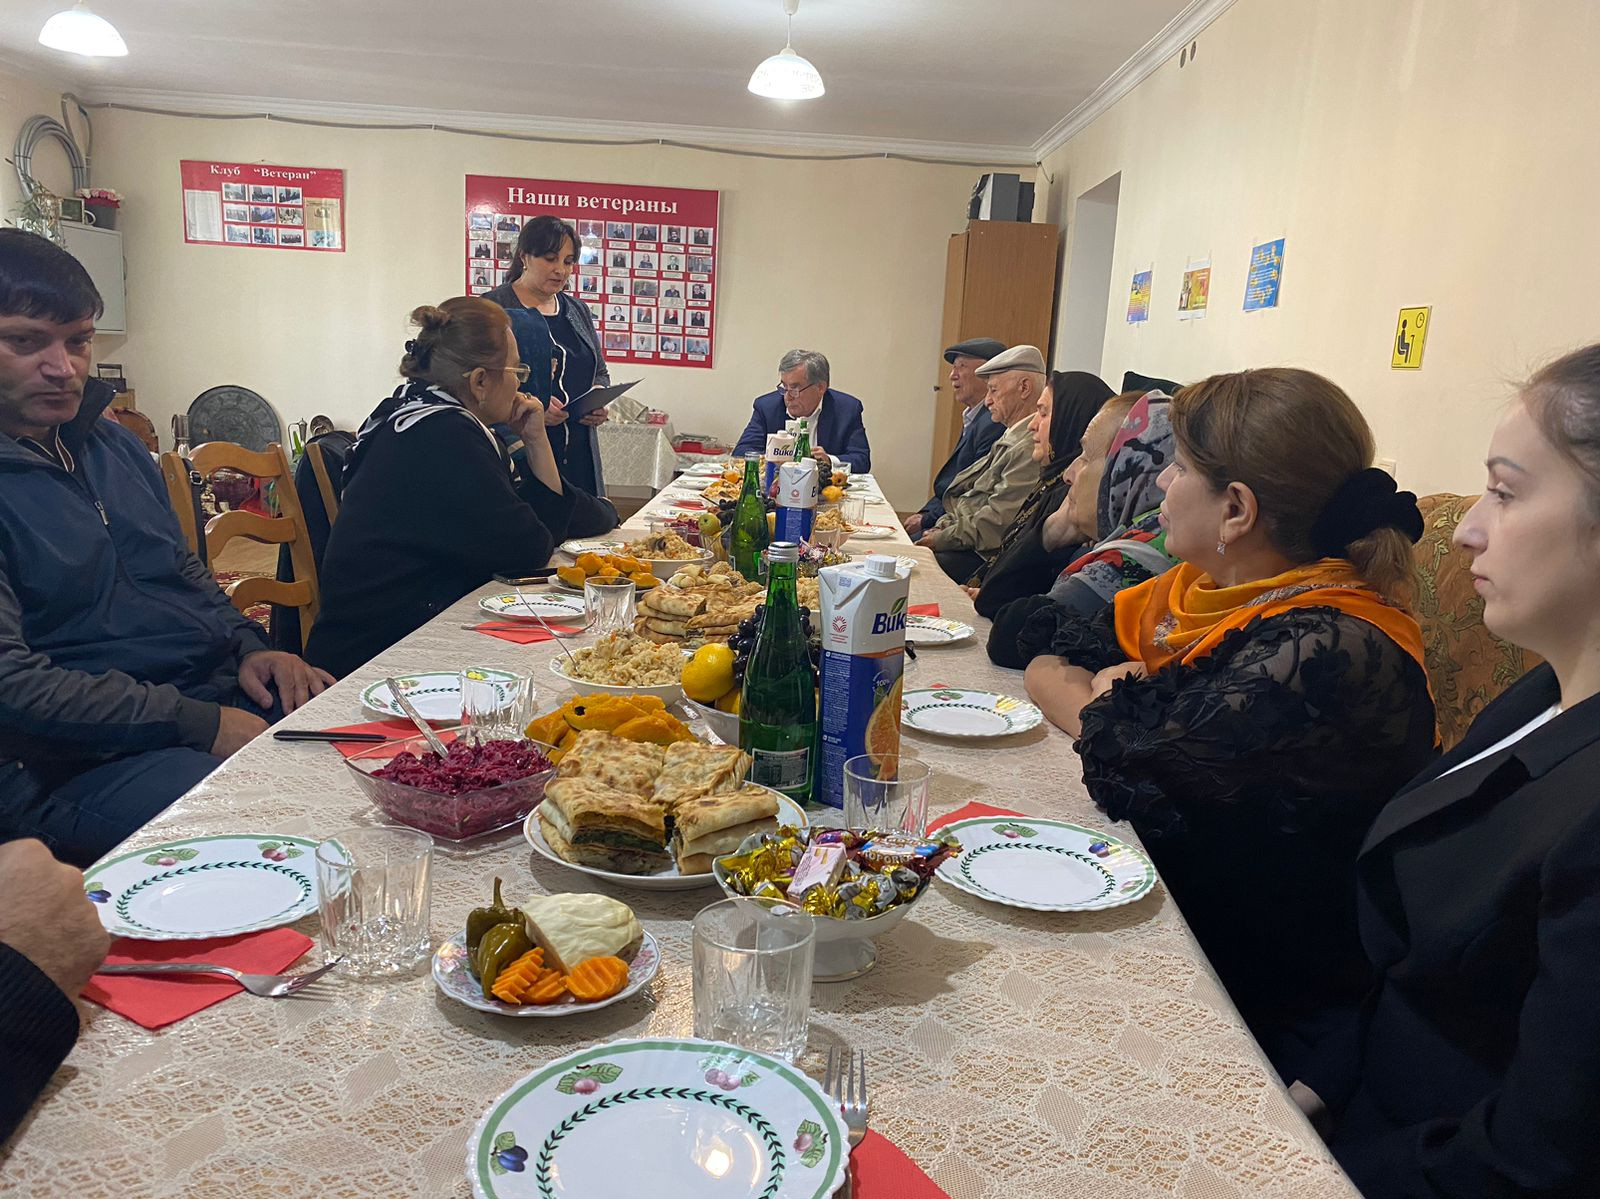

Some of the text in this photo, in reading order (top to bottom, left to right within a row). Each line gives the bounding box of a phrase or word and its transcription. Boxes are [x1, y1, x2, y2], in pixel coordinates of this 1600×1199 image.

[209, 165, 241, 177] Клуб
[507, 187, 678, 215] Наши ветераны
[872, 612, 905, 634] Вик
